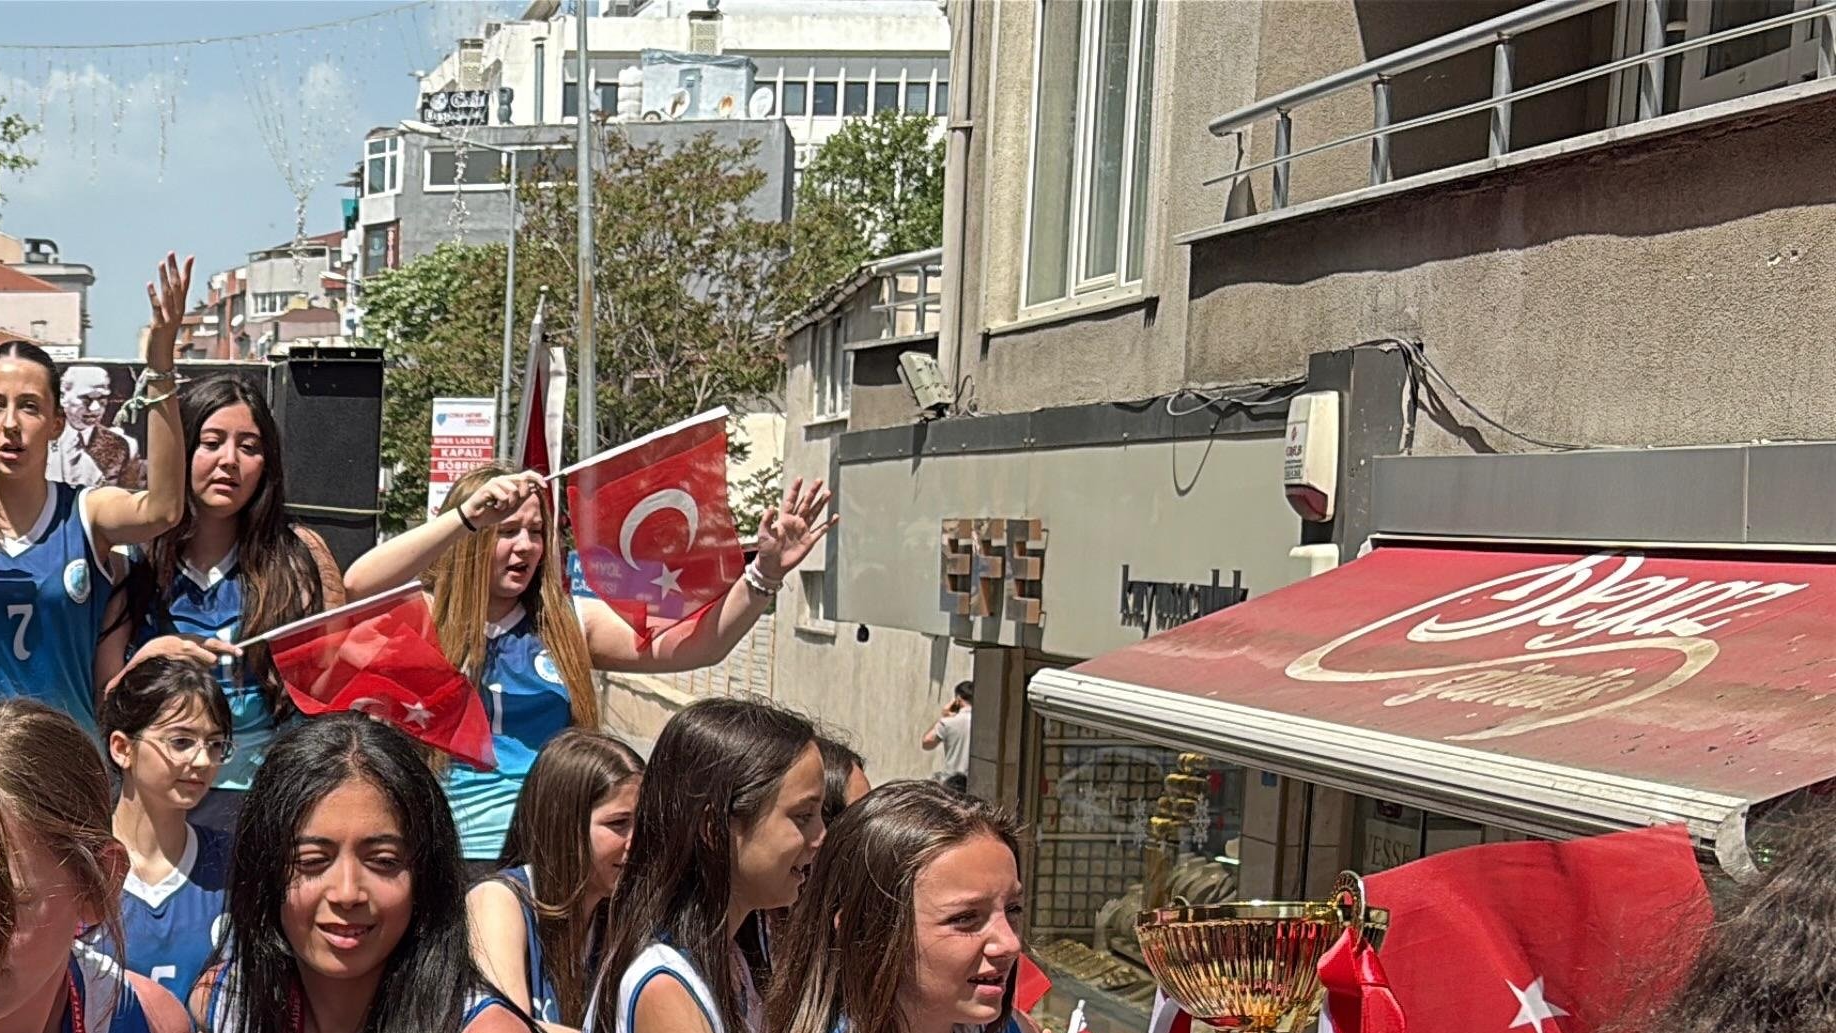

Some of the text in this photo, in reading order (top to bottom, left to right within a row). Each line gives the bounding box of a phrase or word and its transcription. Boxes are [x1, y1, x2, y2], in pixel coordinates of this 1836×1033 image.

[440, 448, 483, 457] KAPALI
[939, 518, 1042, 624] EFE
[6, 603, 33, 661] 7
